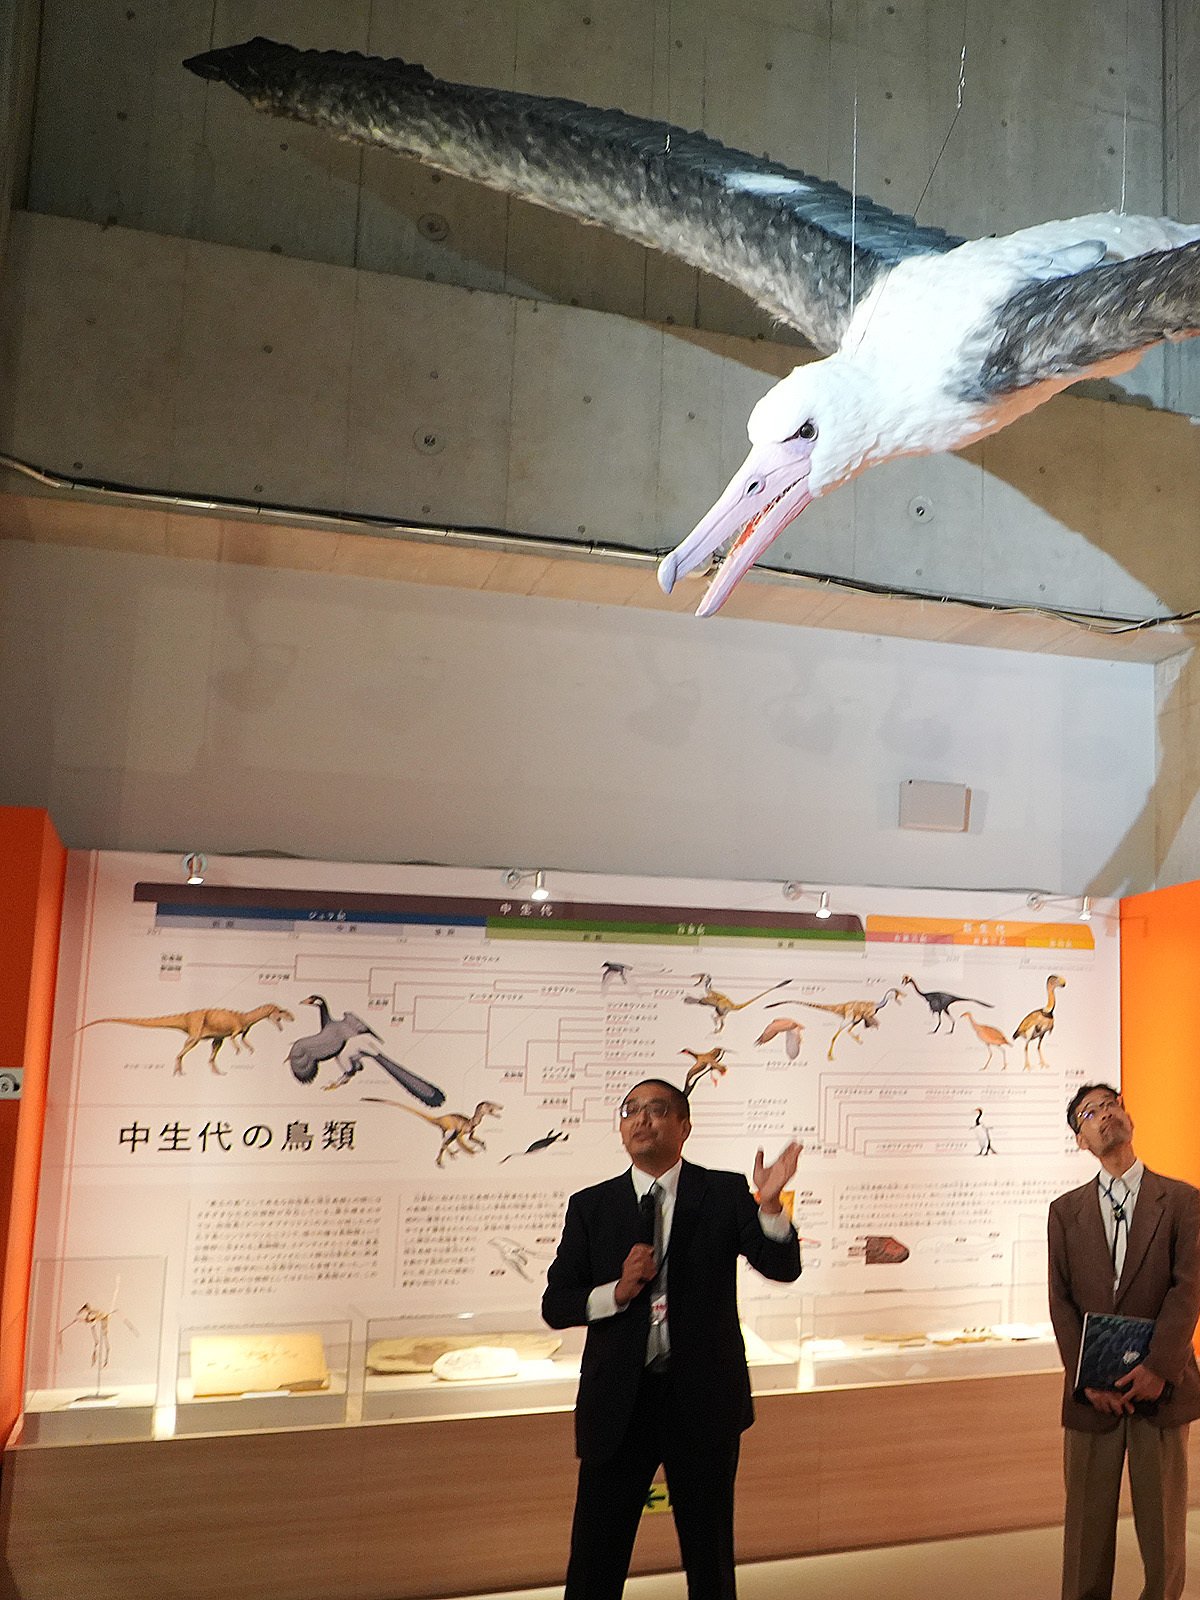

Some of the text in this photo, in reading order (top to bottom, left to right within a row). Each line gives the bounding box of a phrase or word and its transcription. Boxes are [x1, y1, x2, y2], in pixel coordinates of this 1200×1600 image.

[500, 902, 553, 917] 中生代
[119, 1120, 358, 1153] 中生代の鳥類
